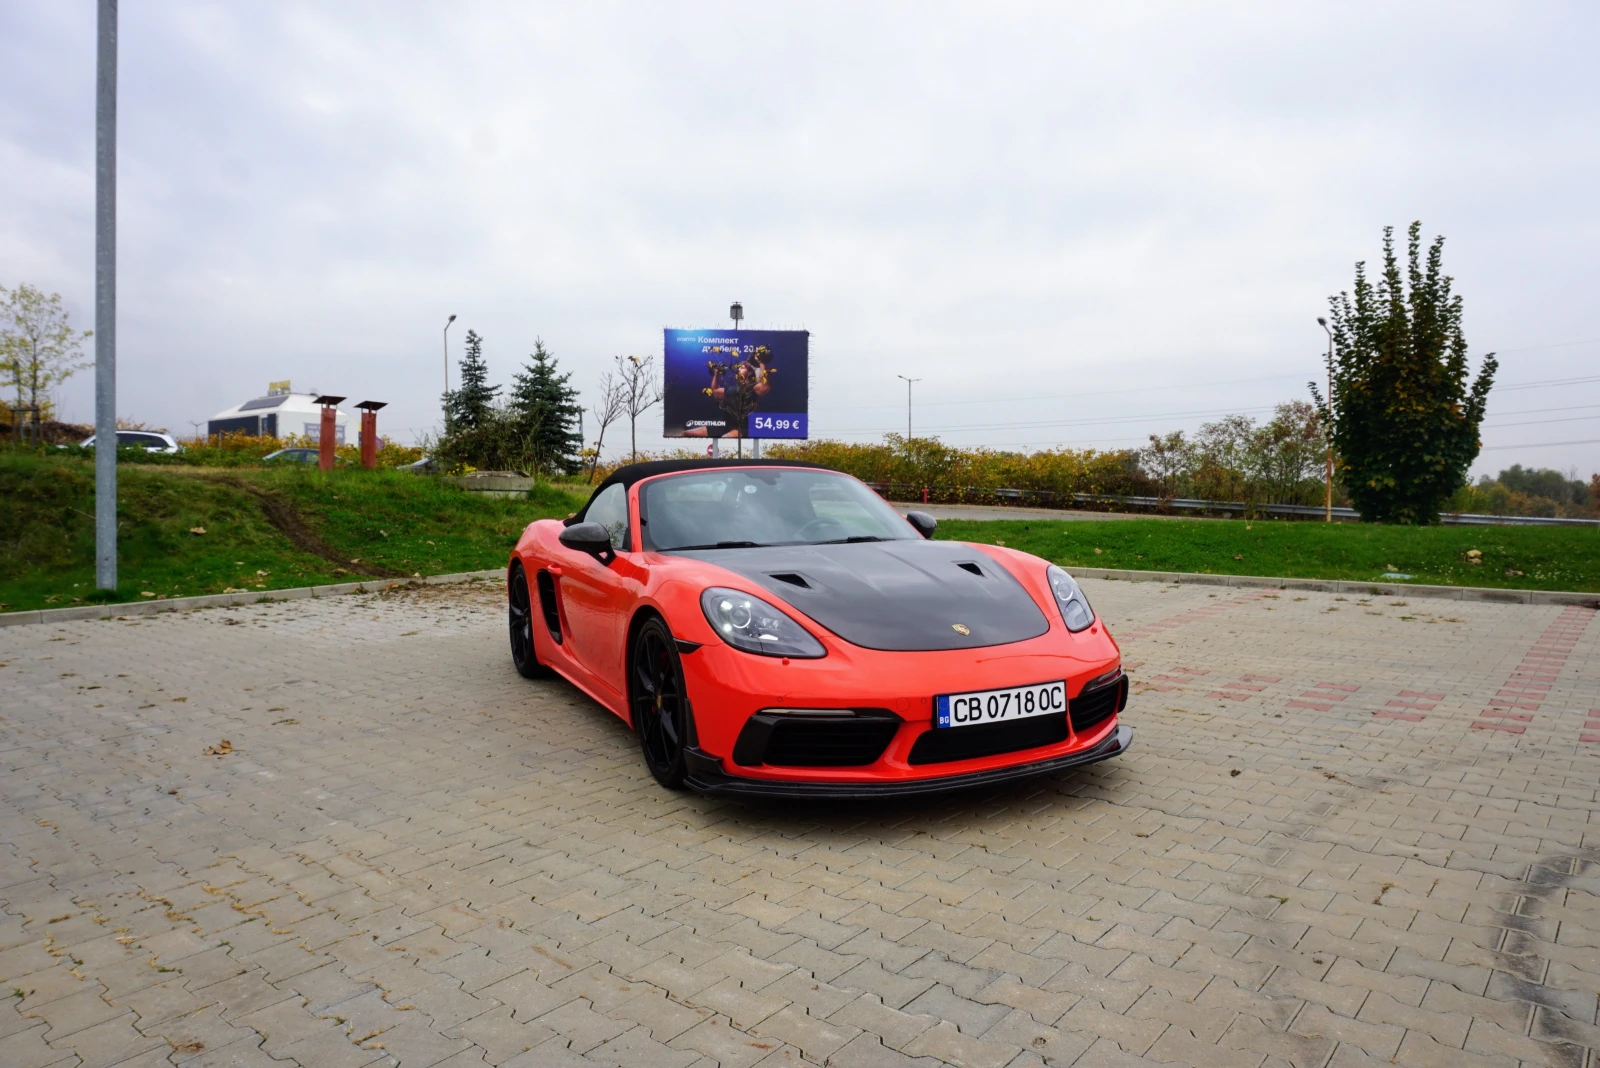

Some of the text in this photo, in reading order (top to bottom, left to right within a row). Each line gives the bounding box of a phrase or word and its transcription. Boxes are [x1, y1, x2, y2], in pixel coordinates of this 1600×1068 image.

[698, 336, 738, 344] Комплект
[755, 417, 799, 431] 54,99 €
[953, 686, 1062, 722] CB 0718 OC
[939, 716, 949, 724] BG
